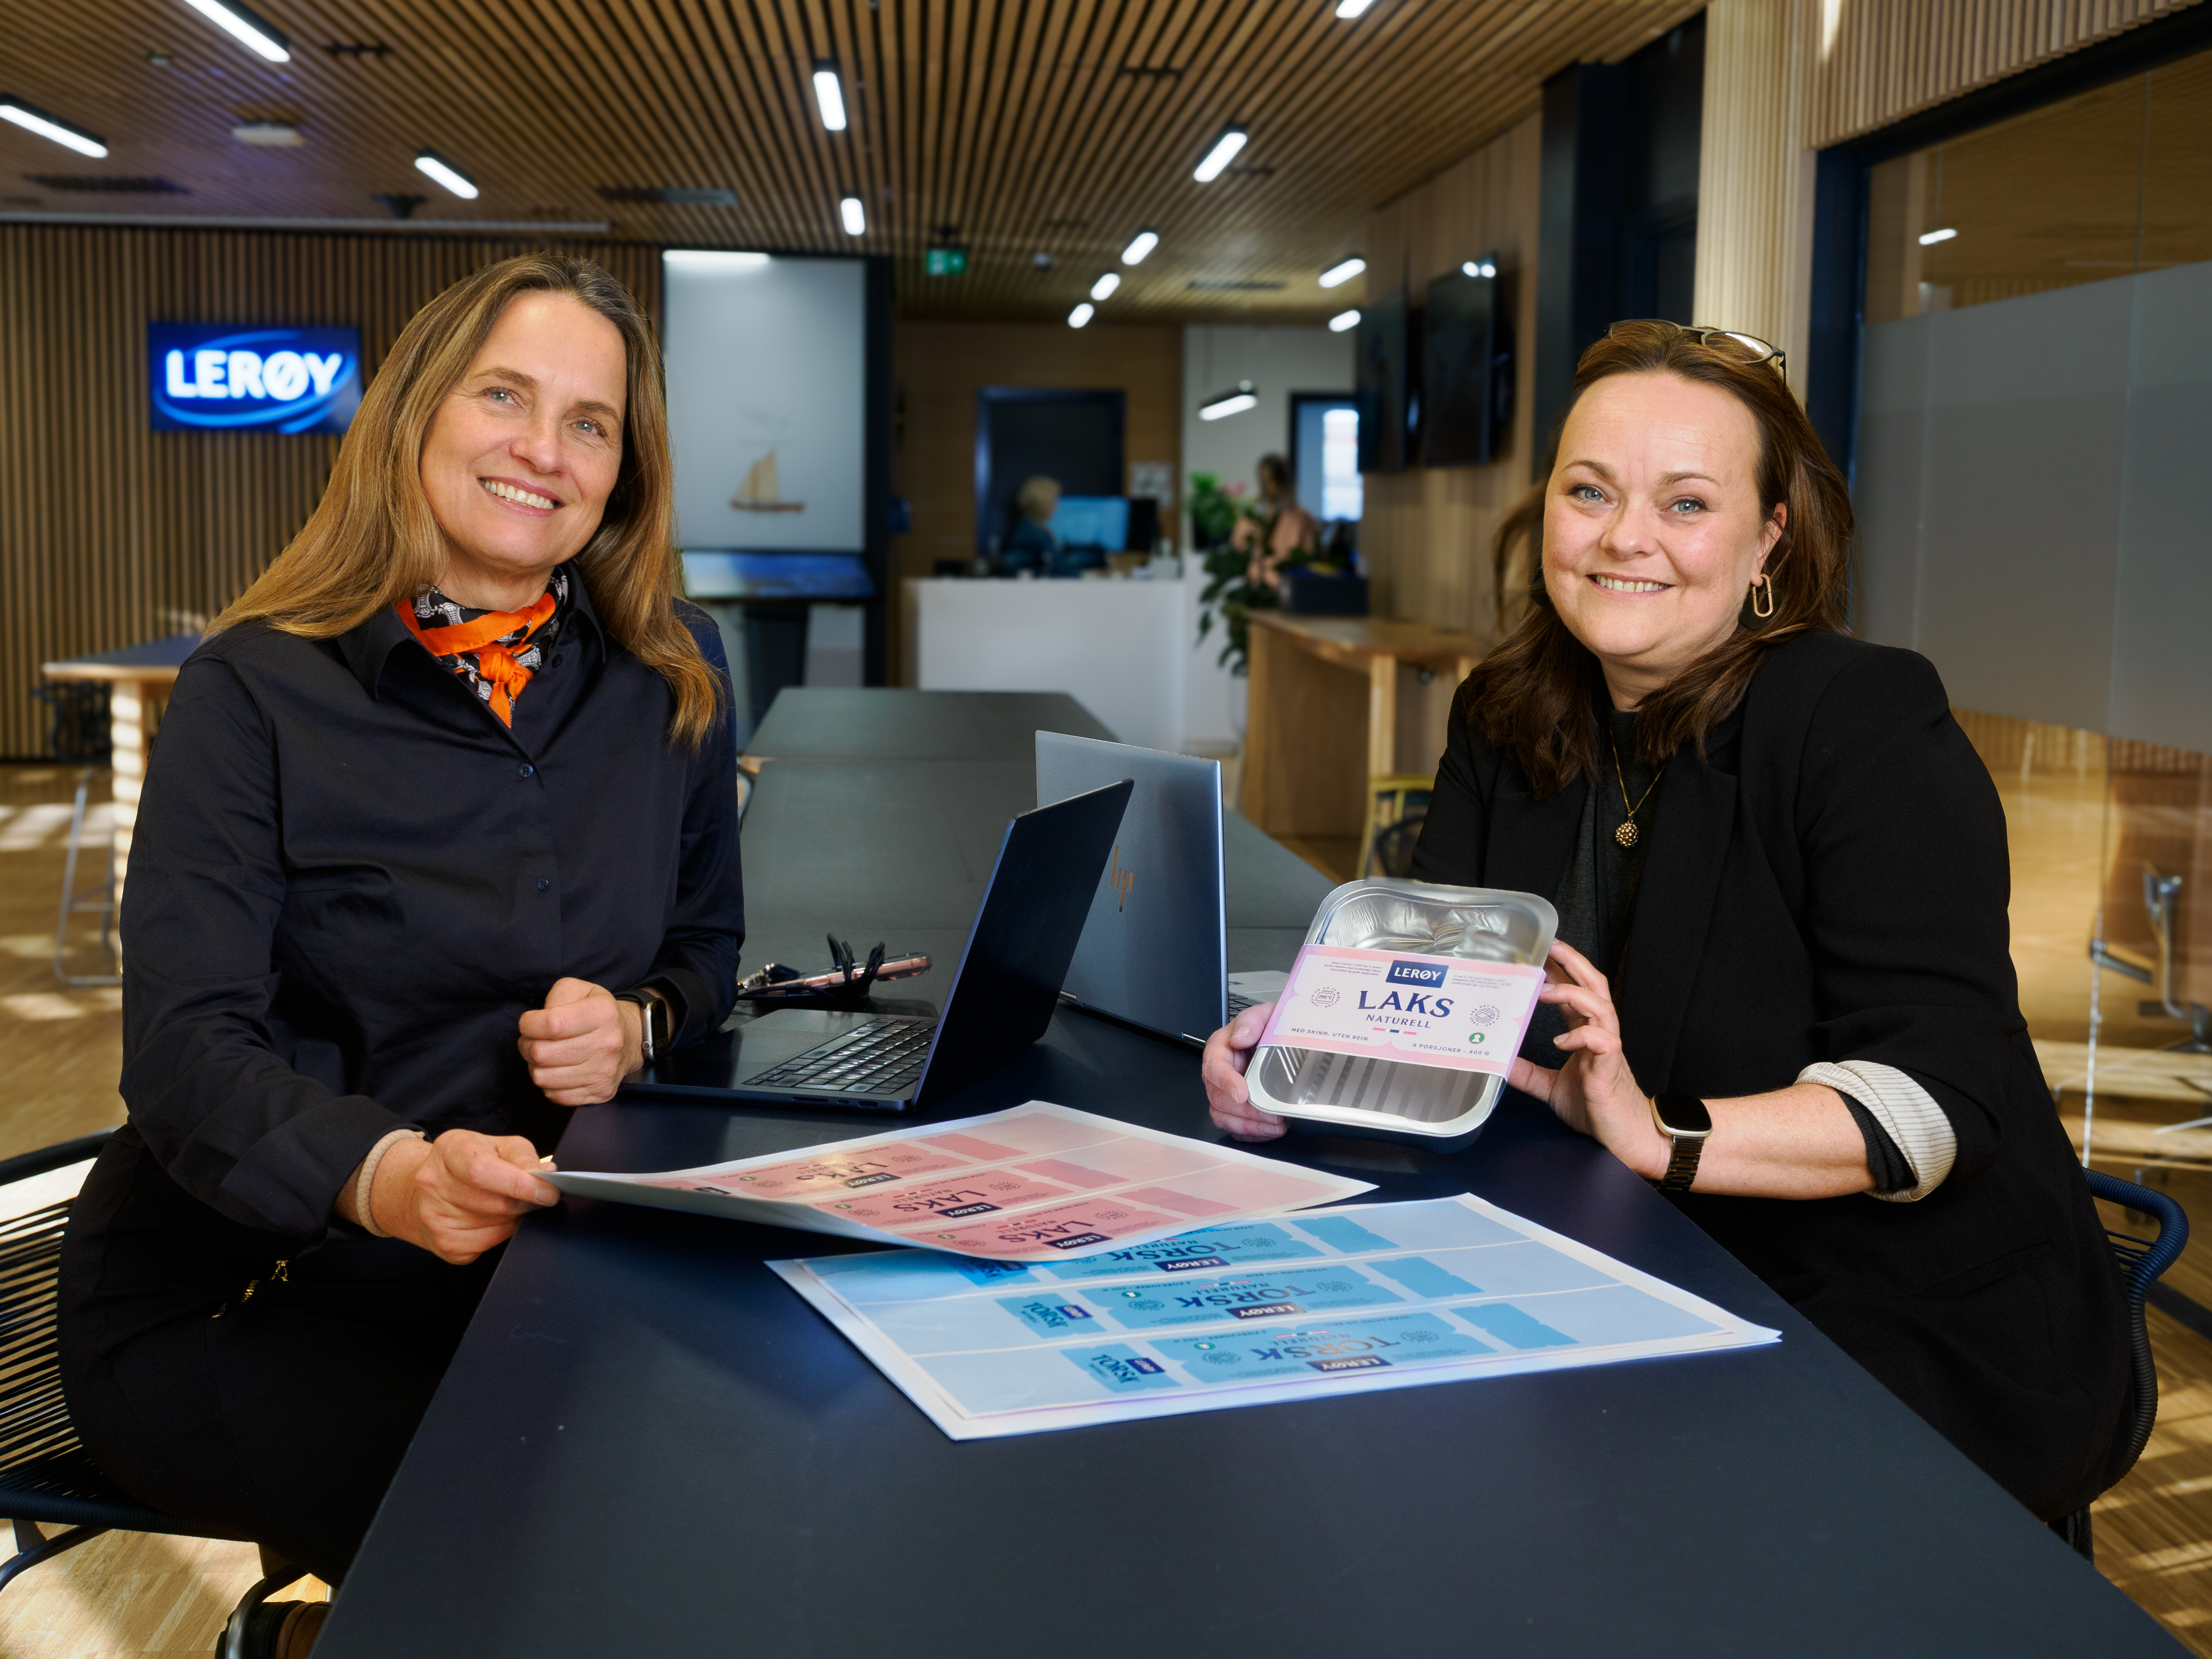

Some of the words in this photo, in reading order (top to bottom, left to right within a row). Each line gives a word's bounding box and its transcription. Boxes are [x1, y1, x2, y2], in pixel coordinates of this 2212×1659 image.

[166, 349, 342, 401] LERØY
[1394, 967, 1441, 981] LERØY
[1357, 991, 1455, 1018] LAKS
[1366, 1014, 1430, 1028] NATURELL
[1419, 1044, 1461, 1053] PORSJONER
[893, 1190, 988, 1211] LAKS
[947, 1205, 991, 1216] LERØY
[998, 1220, 1095, 1243] LAKS
[1056, 1235, 1100, 1247] LERØY
[1106, 1243, 1240, 1261] TORSK
[1167, 1258, 1220, 1269] LERØY
[1174, 1286, 1316, 1307] TORSK
[1240, 1305, 1295, 1317] LERØY
[1250, 1336, 1400, 1361] TORSK
[1322, 1358, 1380, 1370] LERØY
